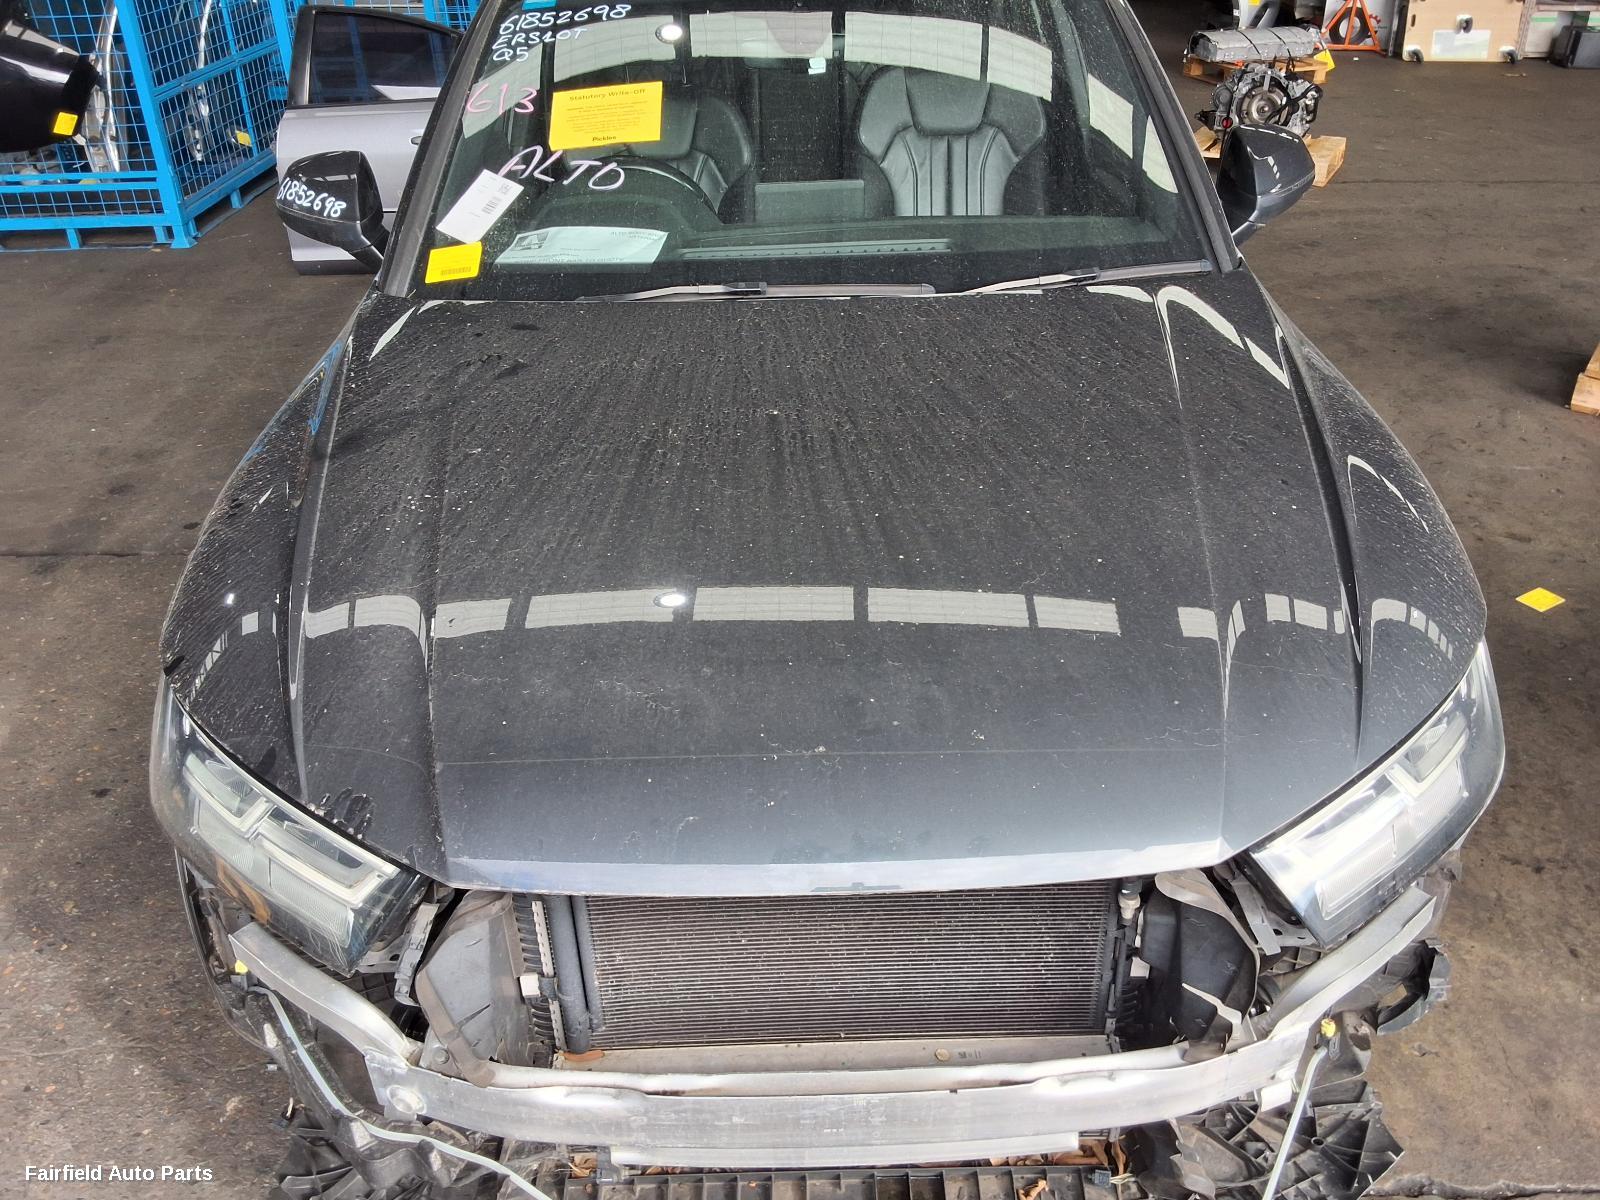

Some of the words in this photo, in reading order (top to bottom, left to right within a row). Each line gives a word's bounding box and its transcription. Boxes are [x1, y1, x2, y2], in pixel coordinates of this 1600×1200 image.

[499, 4, 632, 35] 61852698
[493, 46, 529, 62] Q5
[569, 93, 606, 102] Statutory
[497, 145, 625, 190] ALTO
[277, 177, 347, 217] 61852698
